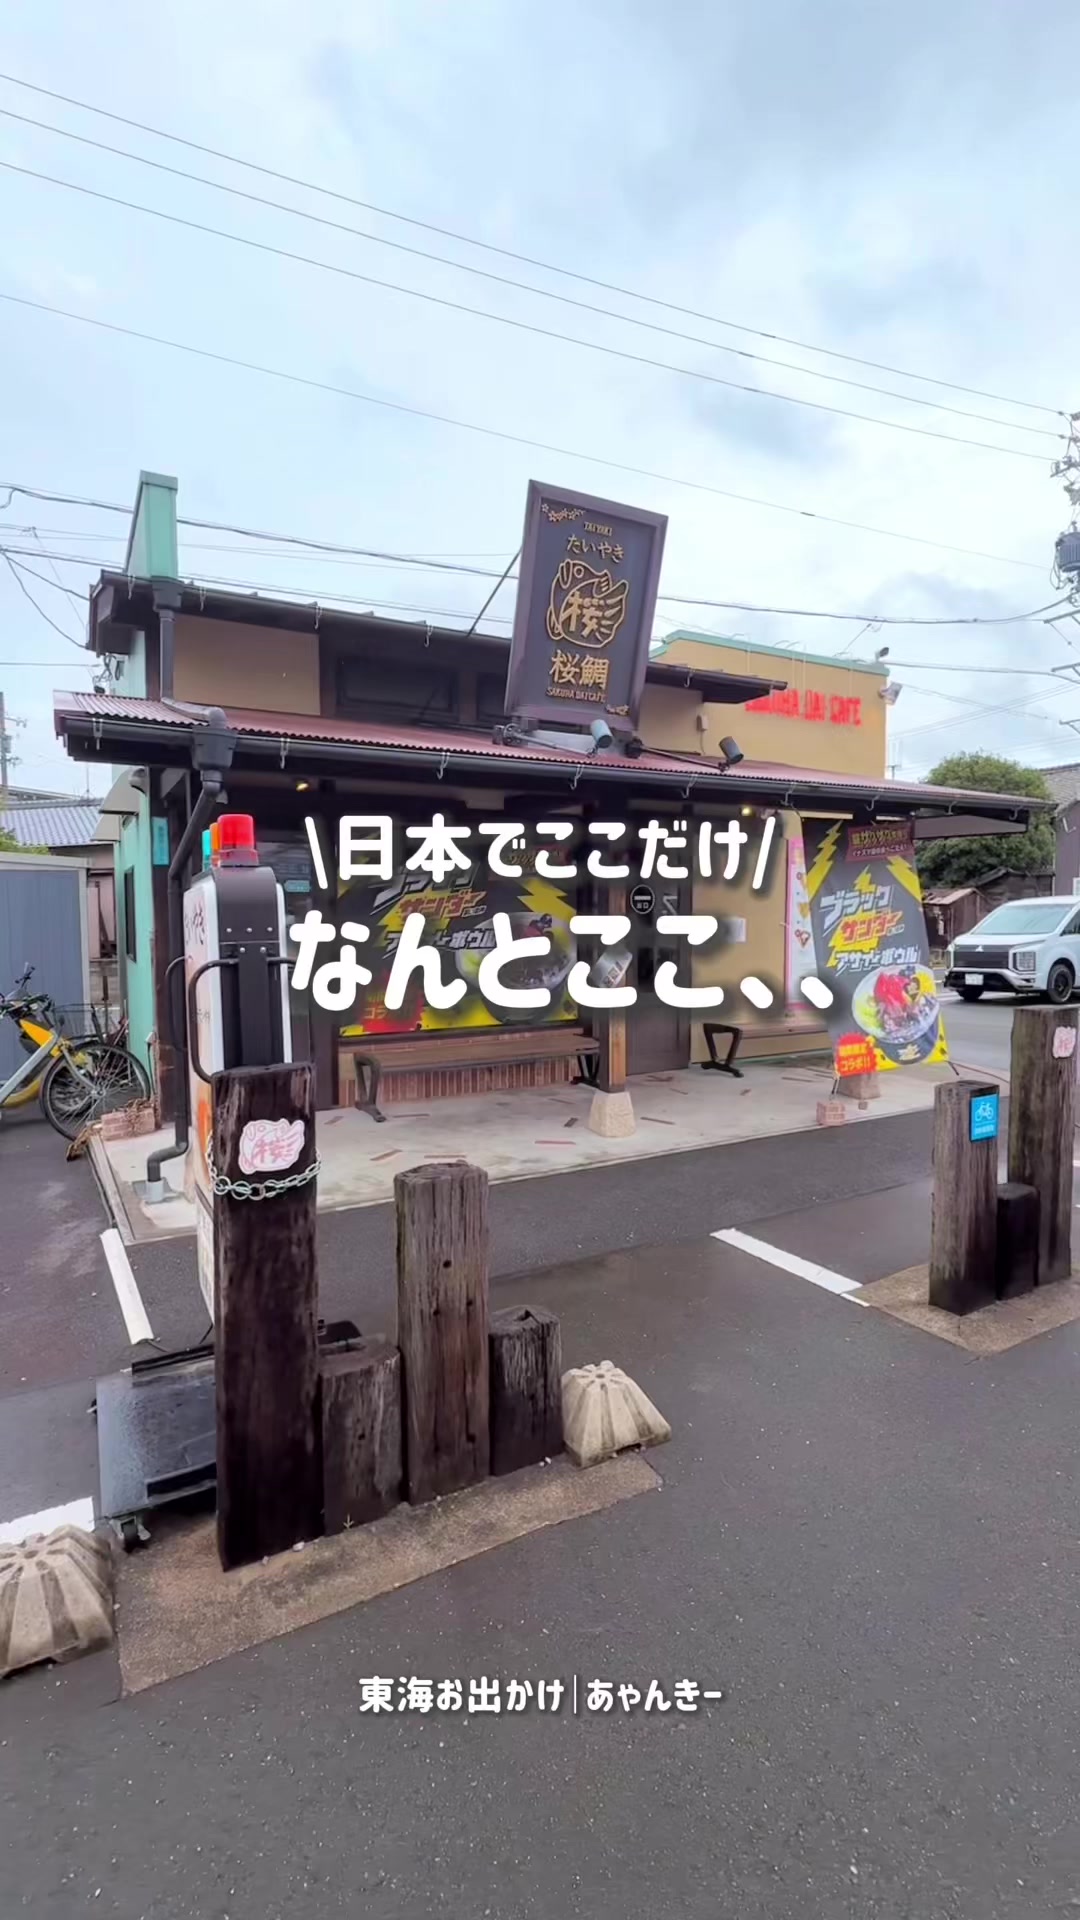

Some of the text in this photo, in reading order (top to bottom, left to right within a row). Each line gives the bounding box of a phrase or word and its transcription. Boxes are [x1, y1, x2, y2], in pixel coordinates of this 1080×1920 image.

[566, 534, 625, 563] たいやき
[549, 649, 610, 690] 桜鯛
[820, 885, 892, 932] ブラック
[841, 910, 902, 944] サンダー
[836, 945, 918, 973] アサイーボウル
